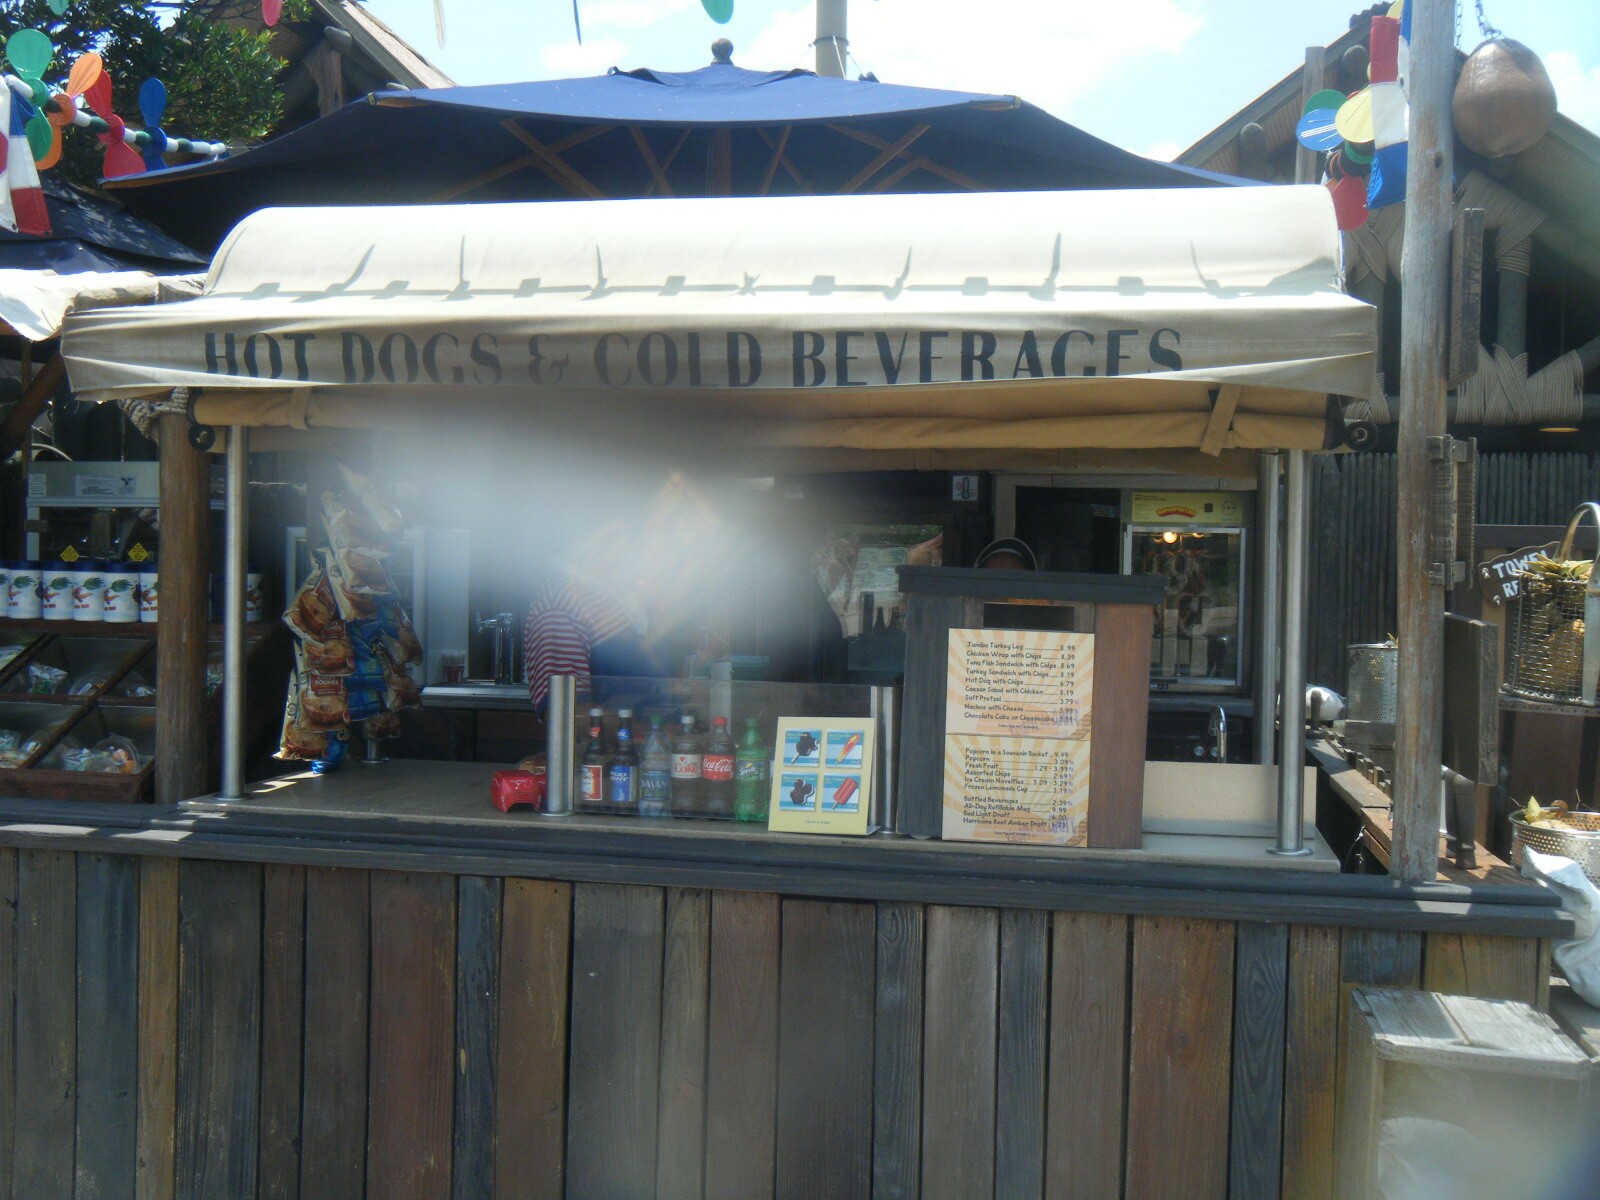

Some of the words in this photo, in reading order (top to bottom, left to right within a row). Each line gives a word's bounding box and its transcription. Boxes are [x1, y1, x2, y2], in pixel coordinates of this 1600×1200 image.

[205, 332, 316, 382] HOT
[341, 332, 501, 385] DOGS
[528, 333, 569, 386] &
[593, 331, 762, 387] COLD
[792, 328, 1183, 387] BEVERAGES
[990, 642, 1011, 651] Turkey
[1012, 644, 1023, 652] Leg
[1040, 662, 1057, 670] Chips
[966, 668, 987, 676] Turkey
[979, 677, 991, 685] Dog
[964, 712, 994, 720] Chocolate
[675, 762, 697, 773] Coke
[740, 765, 758, 776] Sprite
[995, 770, 1011, 778] Chips
[988, 796, 1019, 804] Beverages
[964, 803, 987, 811] All-Day
[1016, 805, 1031, 813] Mug
